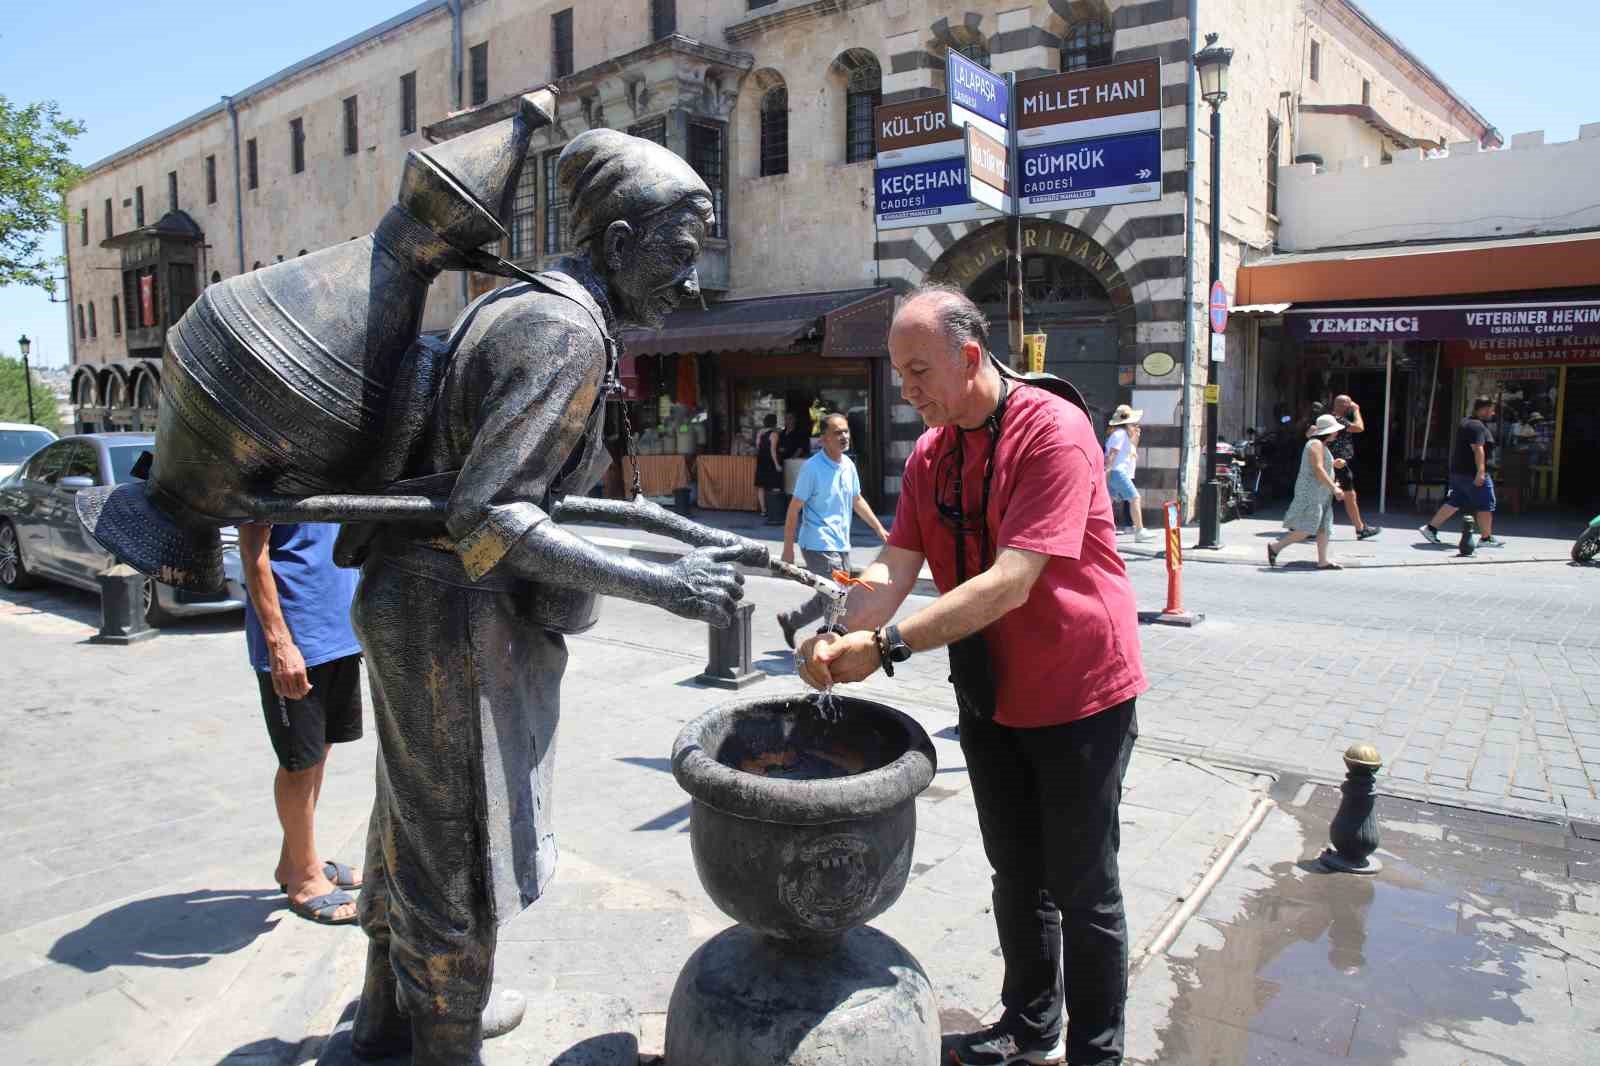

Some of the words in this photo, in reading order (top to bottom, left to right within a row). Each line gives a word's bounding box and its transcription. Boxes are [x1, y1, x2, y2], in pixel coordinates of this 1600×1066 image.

[954, 63, 997, 103] LALAPAŞA
[1023, 86, 1090, 115] MİLLET
[1096, 78, 1145, 104] HANI
[882, 111, 947, 138] KÜLTÜR
[1025, 147, 1105, 177] GÜMRÜK
[1024, 175, 1073, 193] CADDESİ
[880, 194, 925, 210] CADDESİ
